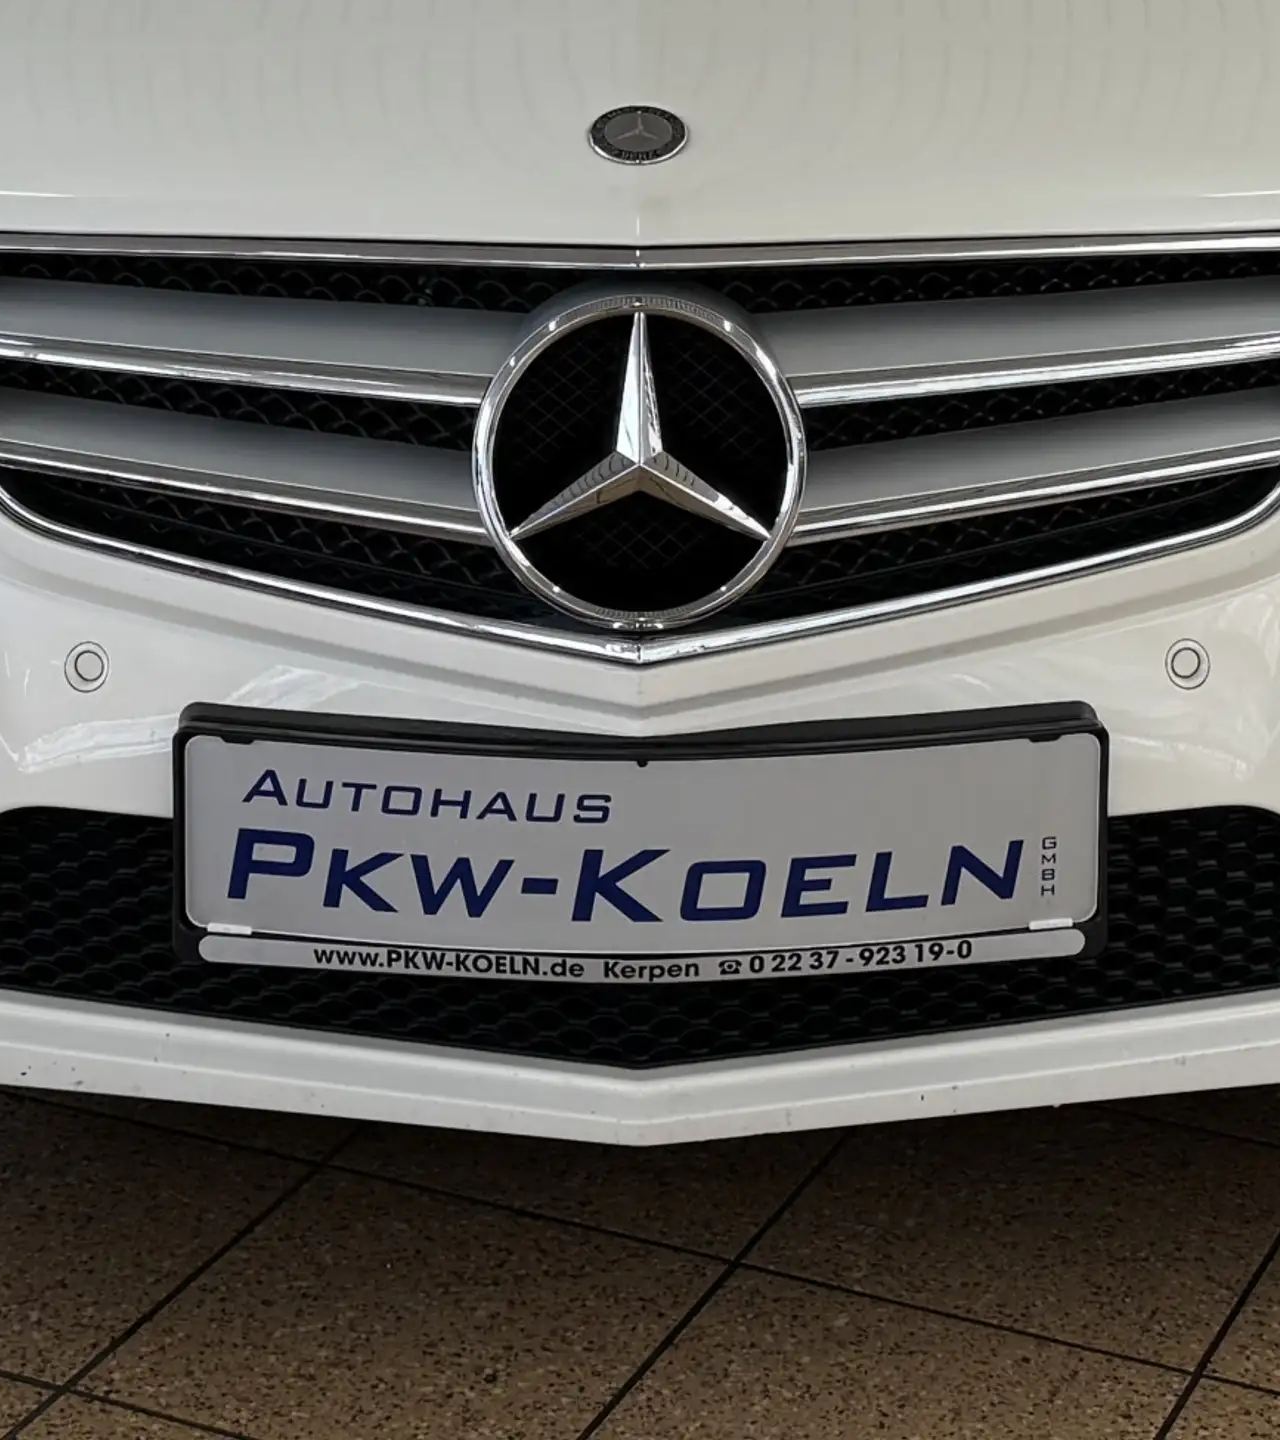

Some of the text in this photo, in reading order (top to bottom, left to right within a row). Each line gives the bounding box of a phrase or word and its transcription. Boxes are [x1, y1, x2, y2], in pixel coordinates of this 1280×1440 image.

[242, 769, 612, 824] AUTOHAUS
[227, 827, 1024, 923] PKW-KOELN
[313, 948, 585, 978] www.PKW-KOELN.de
[603, 960, 700, 982] Kerpen
